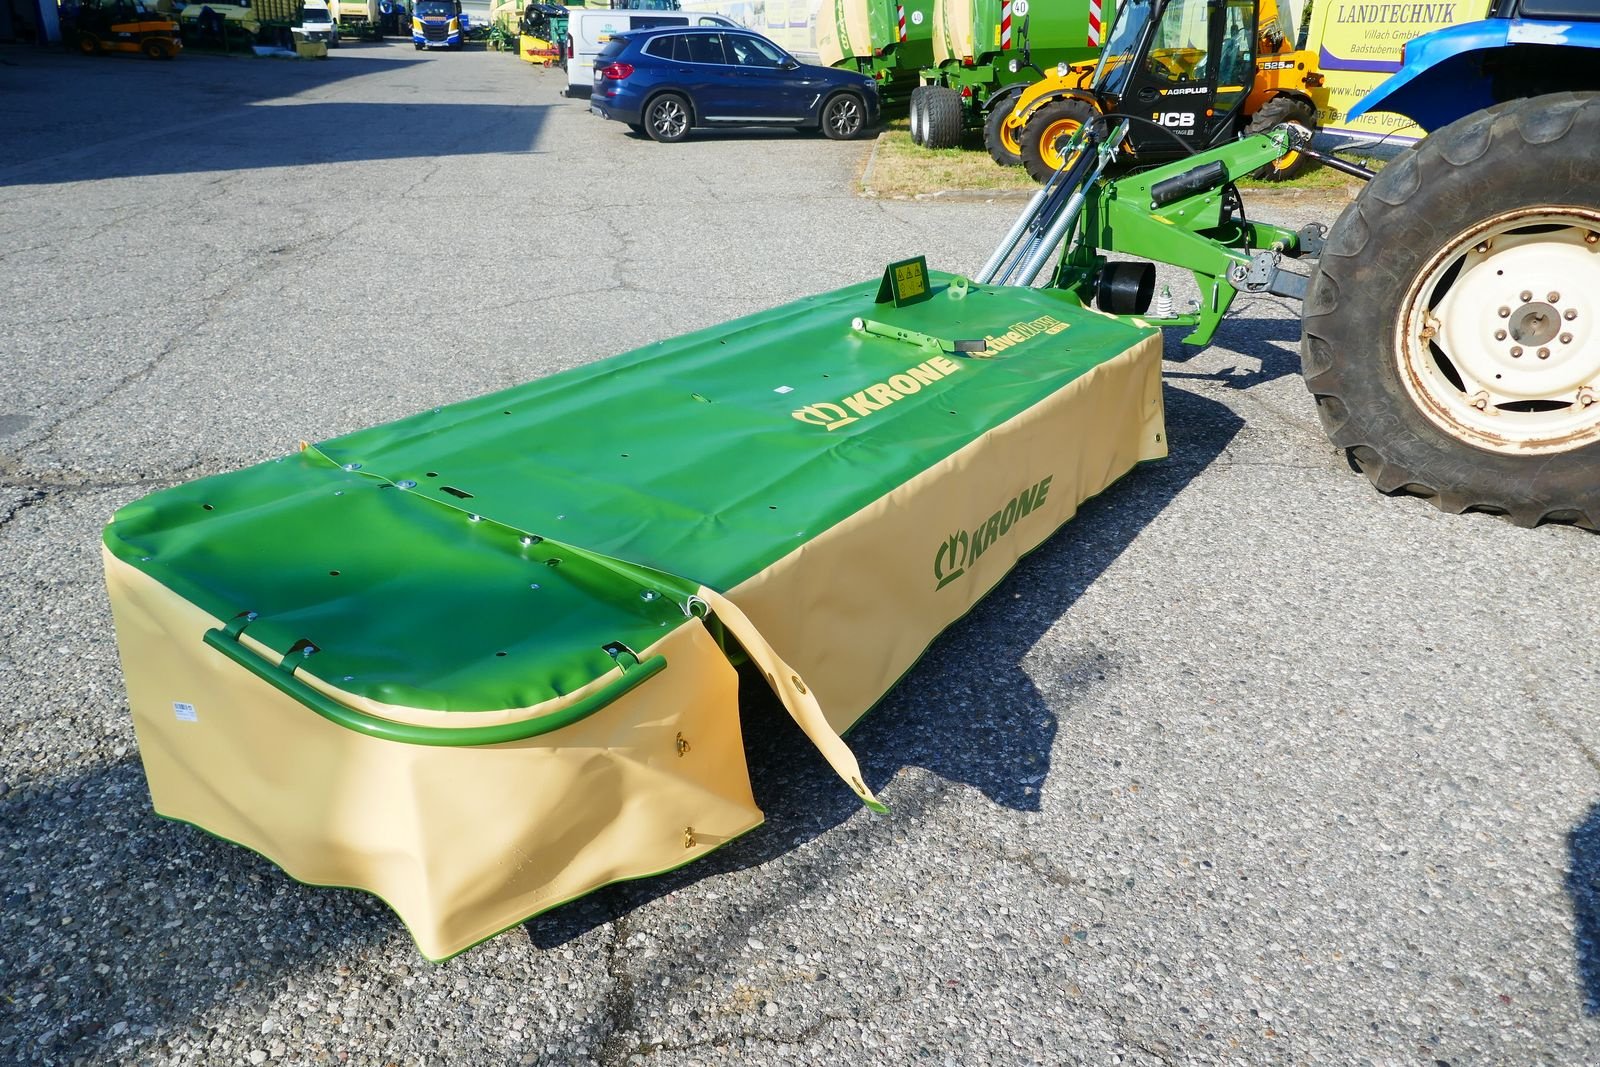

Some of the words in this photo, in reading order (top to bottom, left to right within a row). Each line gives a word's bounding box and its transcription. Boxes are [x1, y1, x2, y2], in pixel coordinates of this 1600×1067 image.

[1014, 2, 1026, 13] 40
[1337, 3, 1457, 23] LANDTECHNIK
[1364, 29, 1390, 39] Villach
[1391, 30, 1420, 40] GmbH
[1350, 43, 1403, 54] Badstubenwe
[1331, 84, 1374, 97] www.land
[1152, 112, 1195, 127] JCB
[842, 355, 961, 417] KRONE
[968, 473, 1054, 569] KRONE
